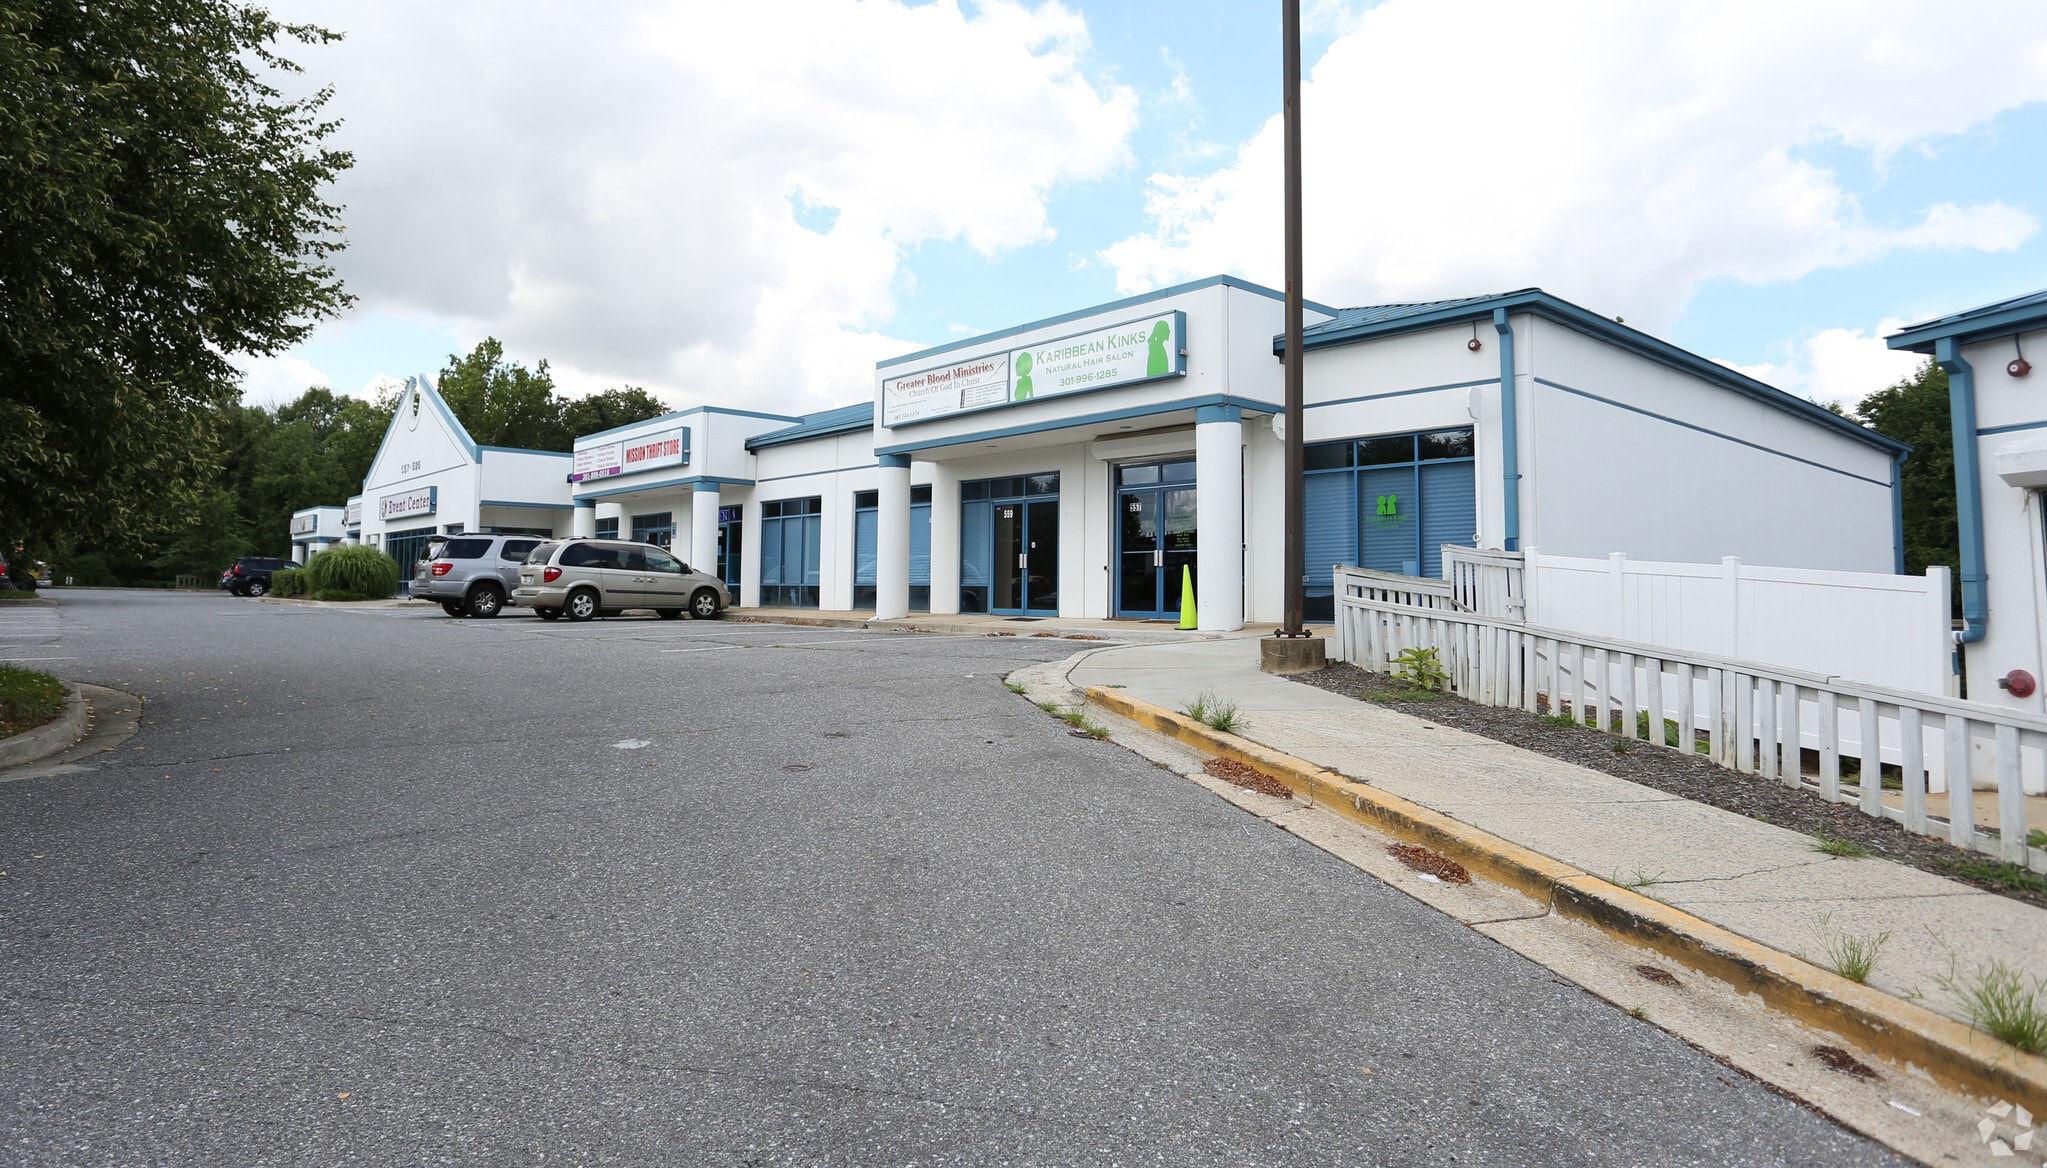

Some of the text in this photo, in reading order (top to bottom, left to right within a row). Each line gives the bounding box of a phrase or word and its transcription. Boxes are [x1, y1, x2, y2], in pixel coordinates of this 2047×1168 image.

[1036, 330, 1146, 365] KARIBBEAN KINKS
[1045, 351, 1134, 375] NATURAL HAIR SALON
[896, 362, 994, 391] Greater Blood Ministries
[909, 386, 930, 398] Church
[939, 382, 953, 392] God
[961, 377, 981, 387] Christ
[1059, 368, 1118, 387] 301-996-1285
[626, 446, 646, 463] MISSION
[646, 441, 663, 459] THRIFT
[663, 438, 679, 456] STORE
[388, 495, 430, 514] Event Center
